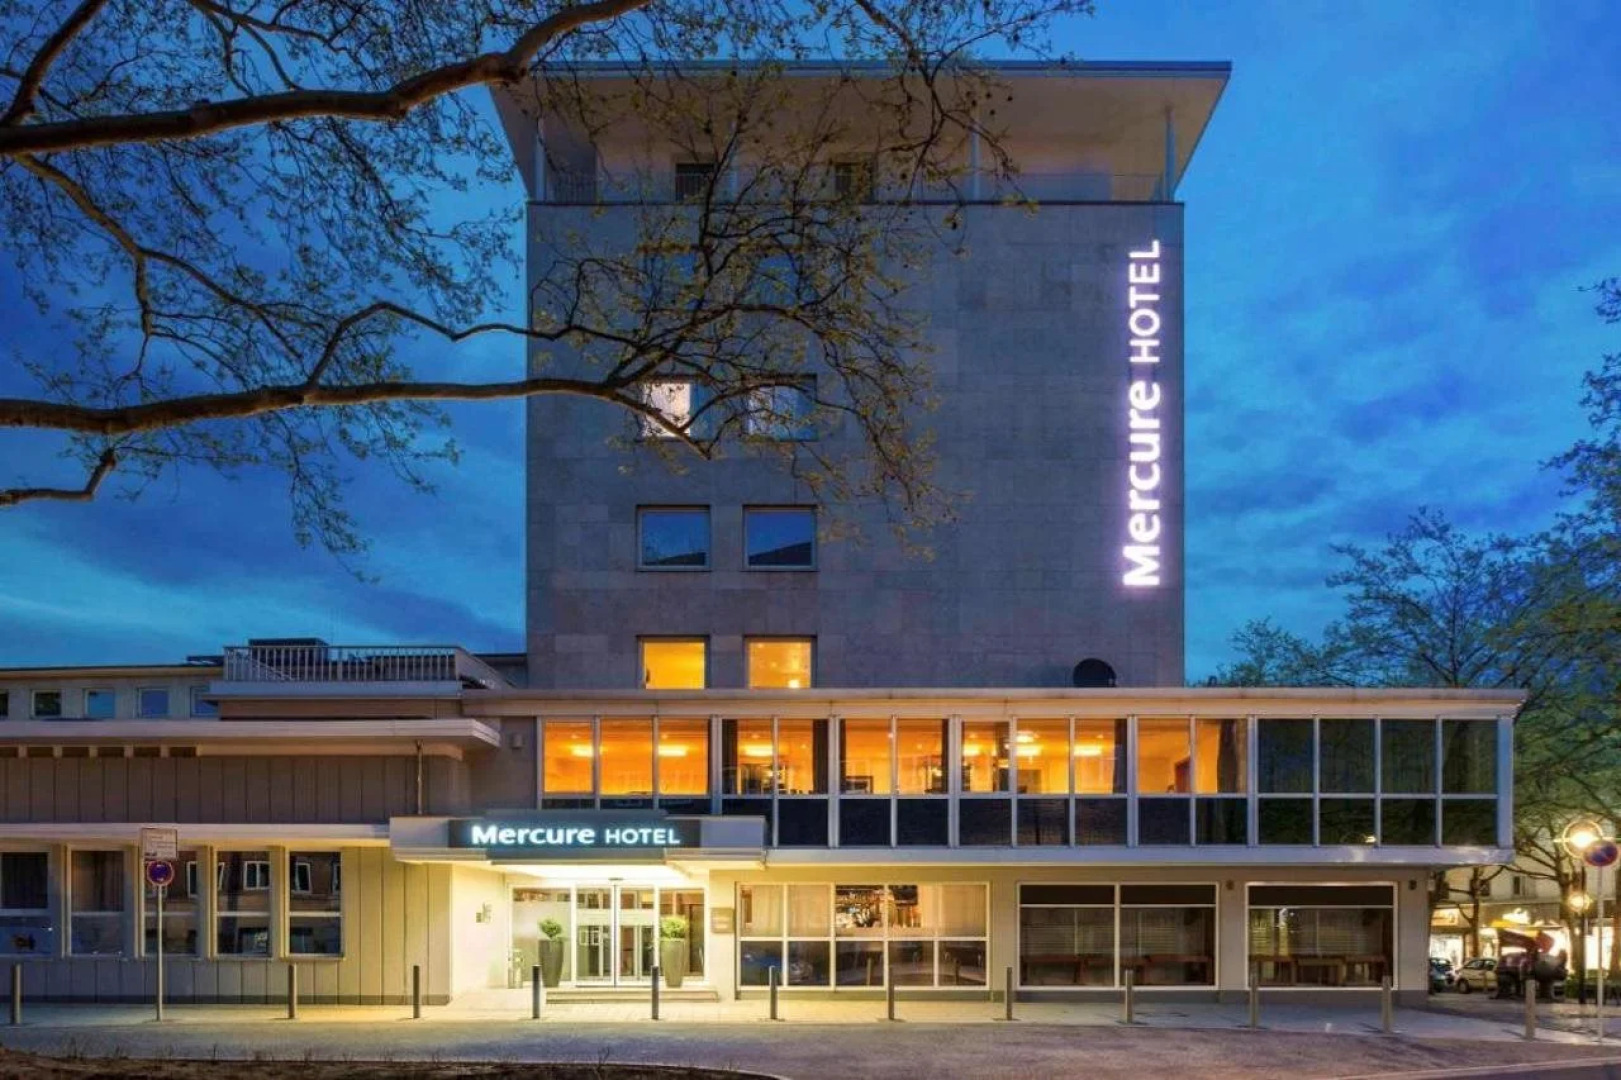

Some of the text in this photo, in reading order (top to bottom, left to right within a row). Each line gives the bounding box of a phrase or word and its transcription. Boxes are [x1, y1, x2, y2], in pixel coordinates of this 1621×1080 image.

[1122, 239, 1161, 586] Mercure HOTEL
[471, 825, 681, 845] Mercure HOTEL
